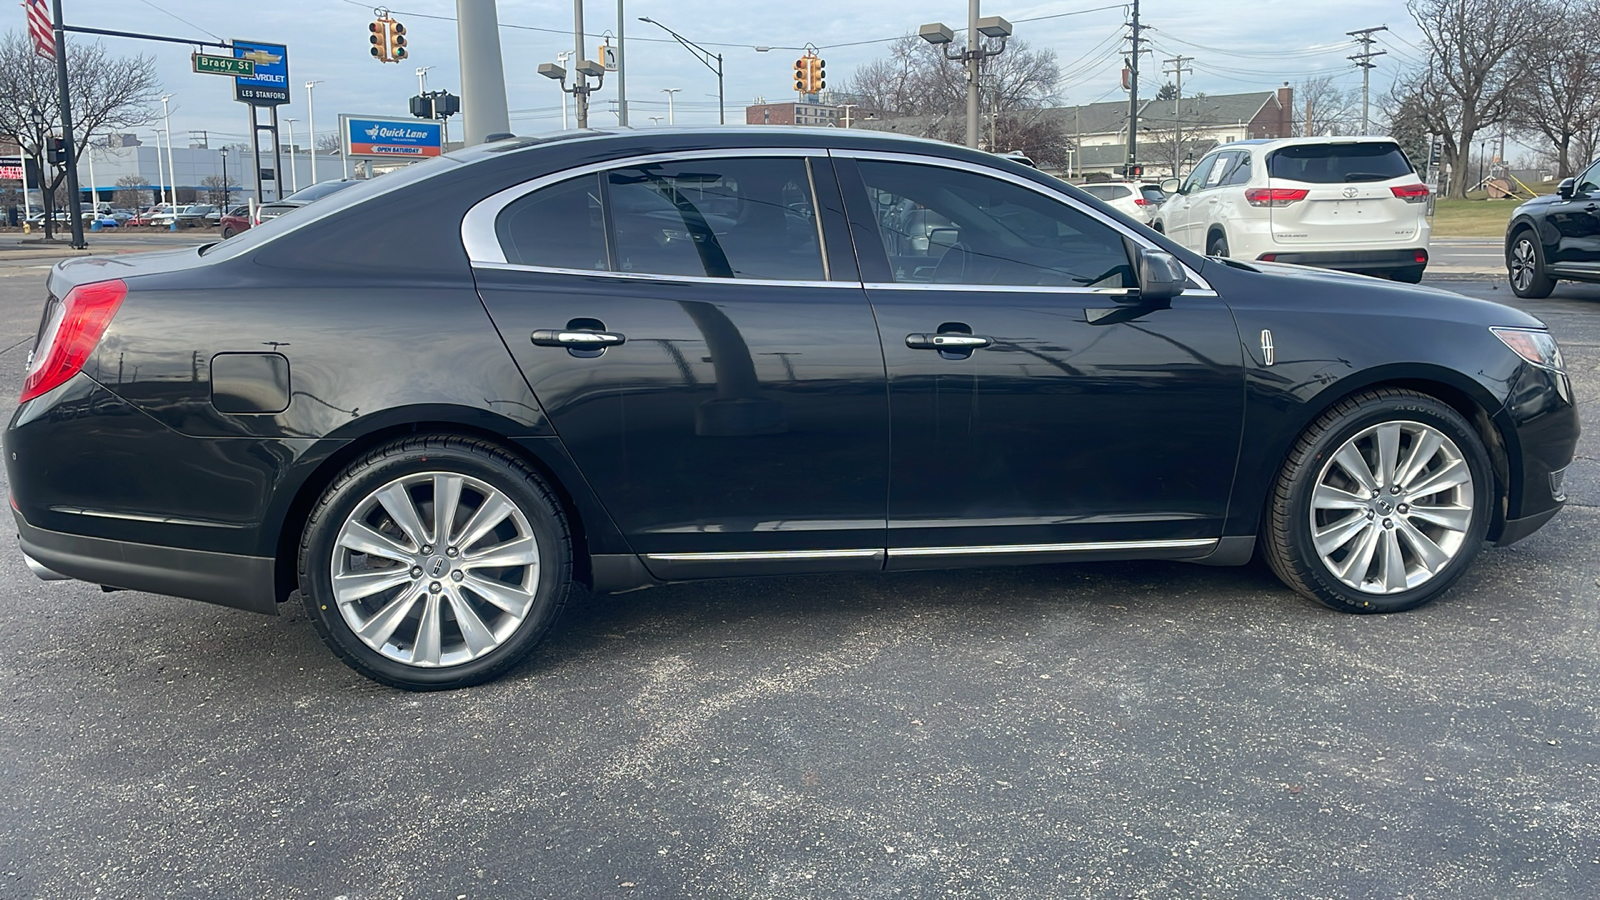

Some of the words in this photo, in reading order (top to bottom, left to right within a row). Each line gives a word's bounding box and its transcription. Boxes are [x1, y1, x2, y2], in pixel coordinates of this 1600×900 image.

[201, 57, 233, 70] Brady
[238, 61, 249, 70] St
[240, 73, 285, 83] VROLET
[241, 89, 253, 98] LES
[256, 90, 286, 100] STANFORD
[380, 127, 404, 137] Quick
[406, 129, 428, 139] Lane
